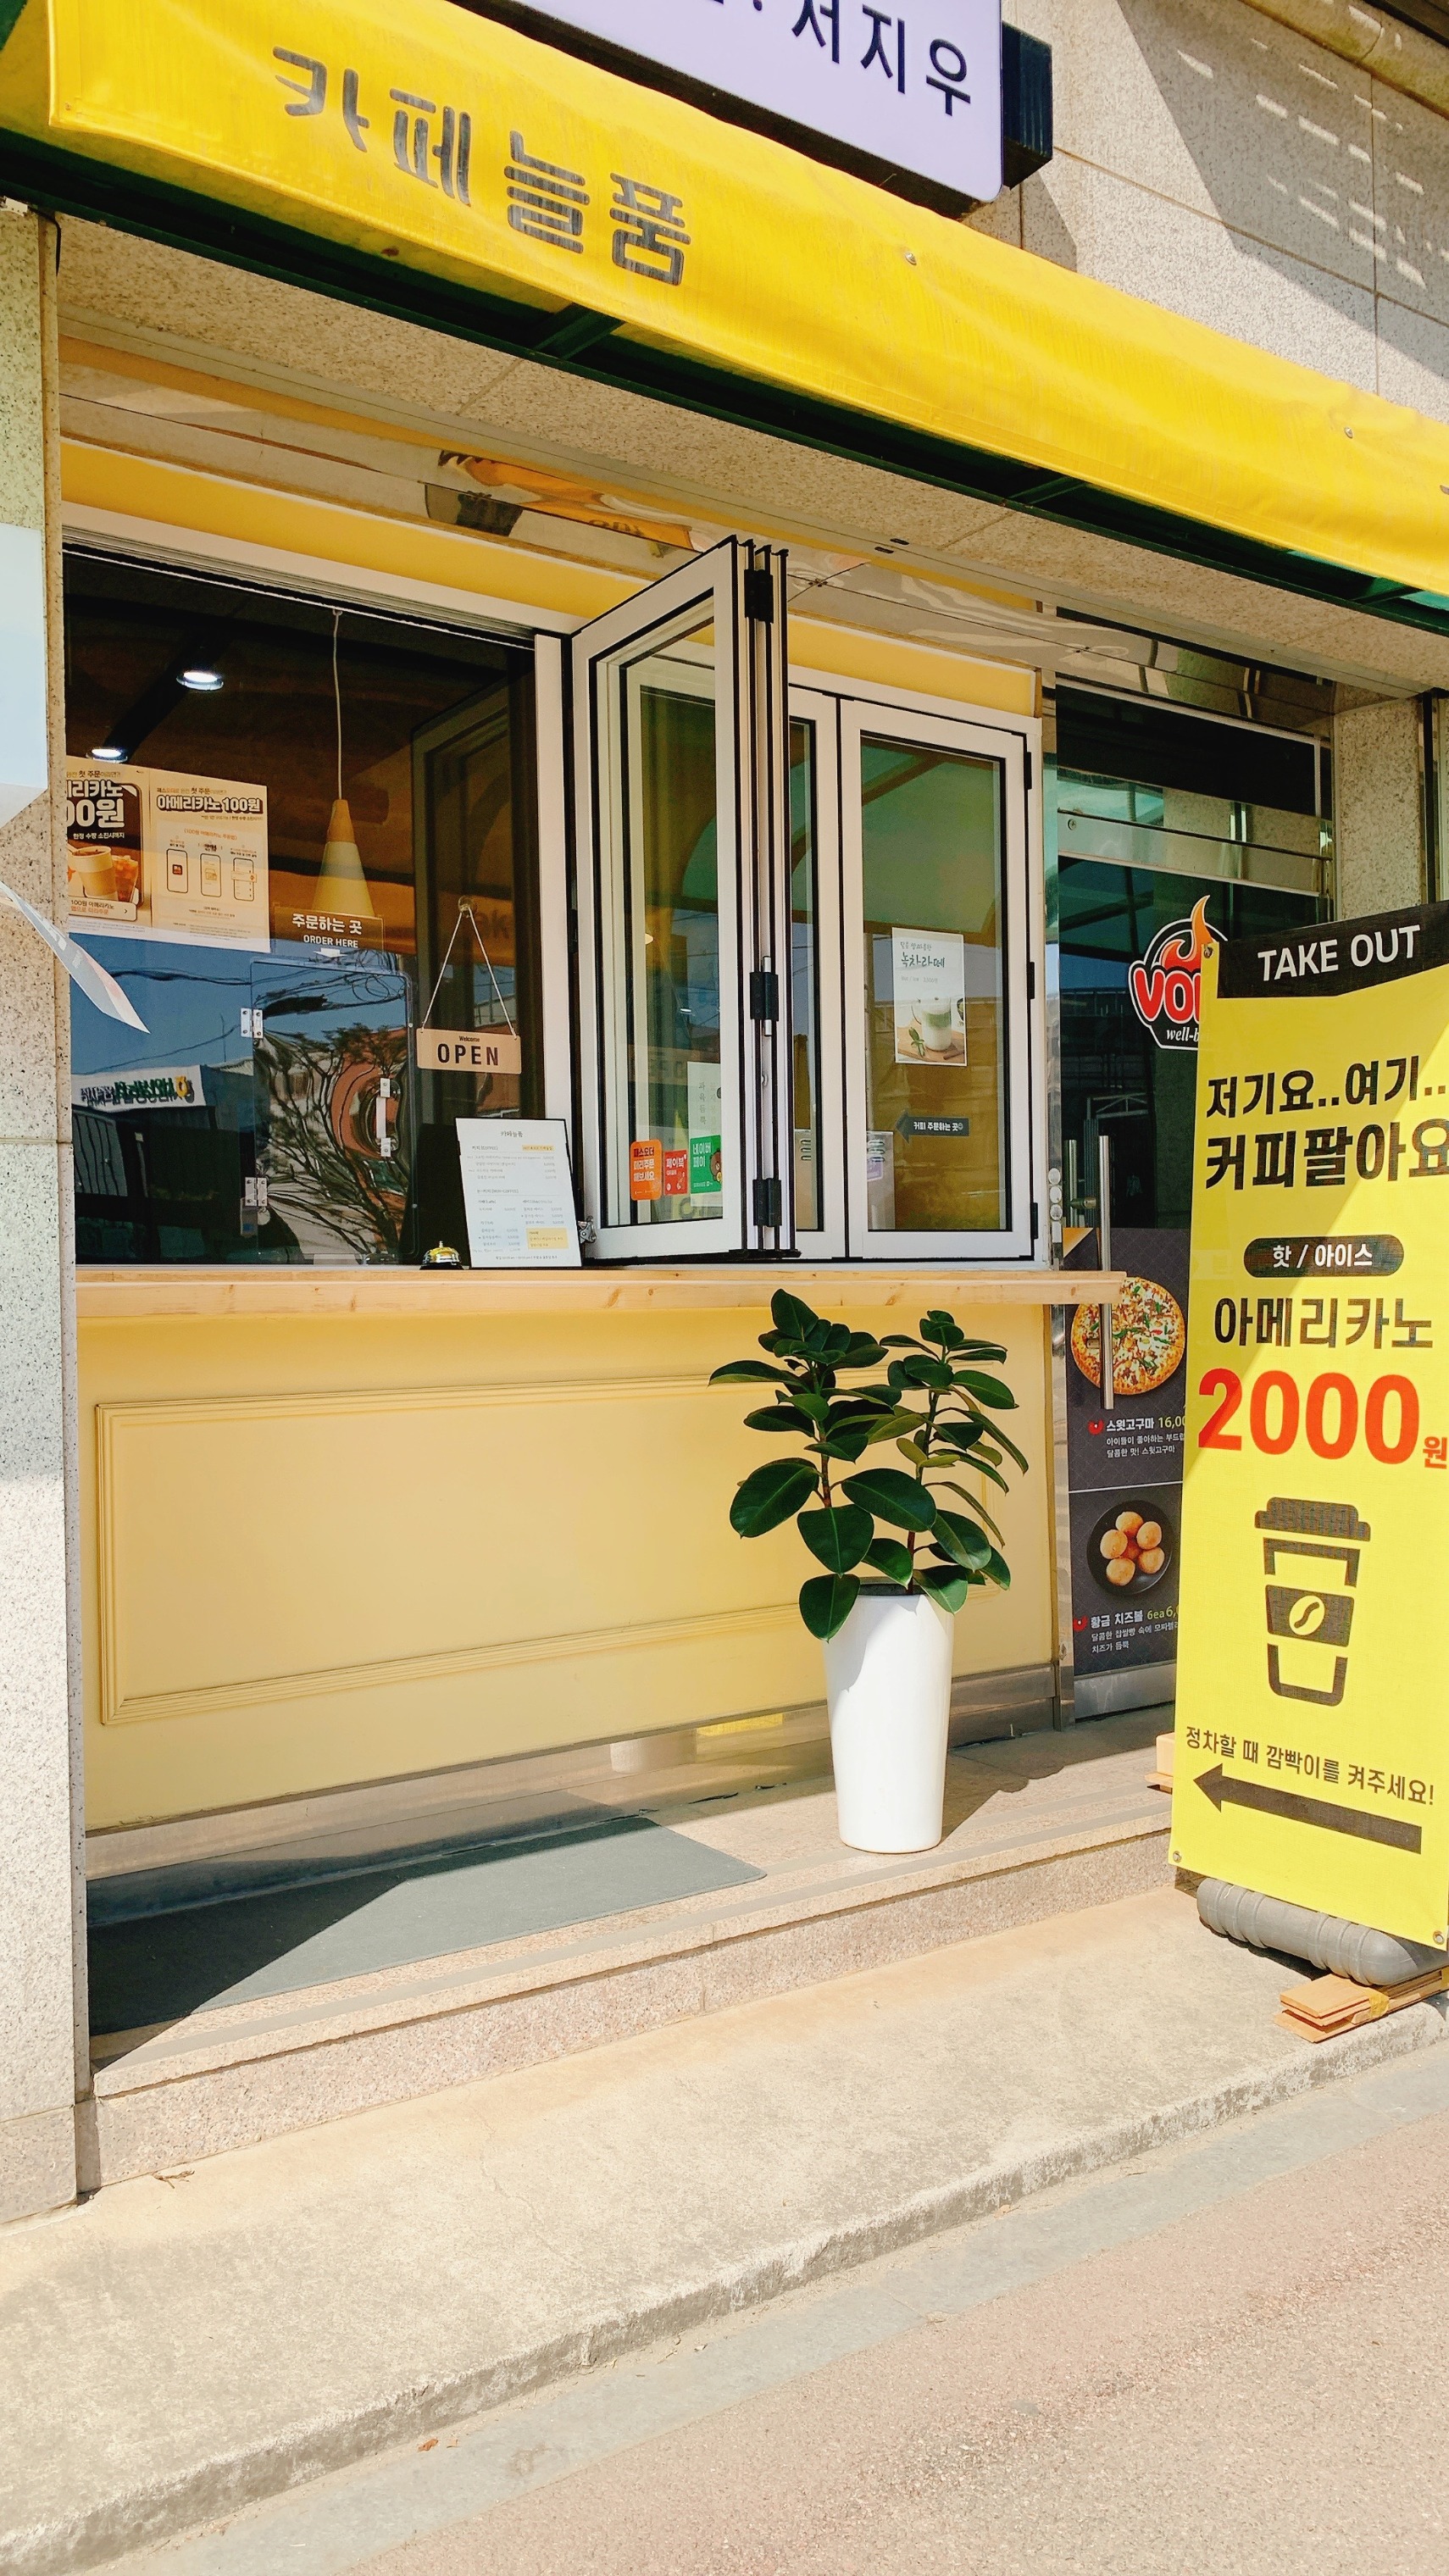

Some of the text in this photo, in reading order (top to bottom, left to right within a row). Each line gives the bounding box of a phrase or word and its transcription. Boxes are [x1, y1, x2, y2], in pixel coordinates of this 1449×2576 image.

[157, 795, 264, 813] 아메리카노 100원
[292, 913, 362, 935] 주문하는 곳
[303, 935, 358, 948] ORDER HERE
[901, 951, 946, 968] 녹차라떼
[1257, 924, 1421, 982] TAKE OUT
[437, 1043, 498, 1066] OPEN
[913, 1121, 926, 1130] 커피
[927, 1122, 951, 1131] 주문하는
[692, 1141, 711, 1154] 네이버
[1206, 1118, 1449, 1191] 커피팔아요
[1273, 1245, 1291, 1268] 핫
[1314, 1243, 1373, 1268] 아이스
[1214, 1297, 1434, 1349] 아메리카노
[1106, 1418, 1154, 1431] 스윗고구마
[1106, 1435, 1134, 1446] 아이들이
[1107, 1448, 1128, 1457] 달콤한
[1141, 1445, 1175, 1455] 스윗고구마
[1091, 1614, 1110, 1629] 황금
[1114, 1609, 1143, 1624] 치즈볼
[1091, 1630, 1113, 1642] 달콤한
[1091, 1642, 1113, 1653] 치즈가
[1186, 1726, 1435, 1806] 정차할 때 깜빡이를 켜주세요!
